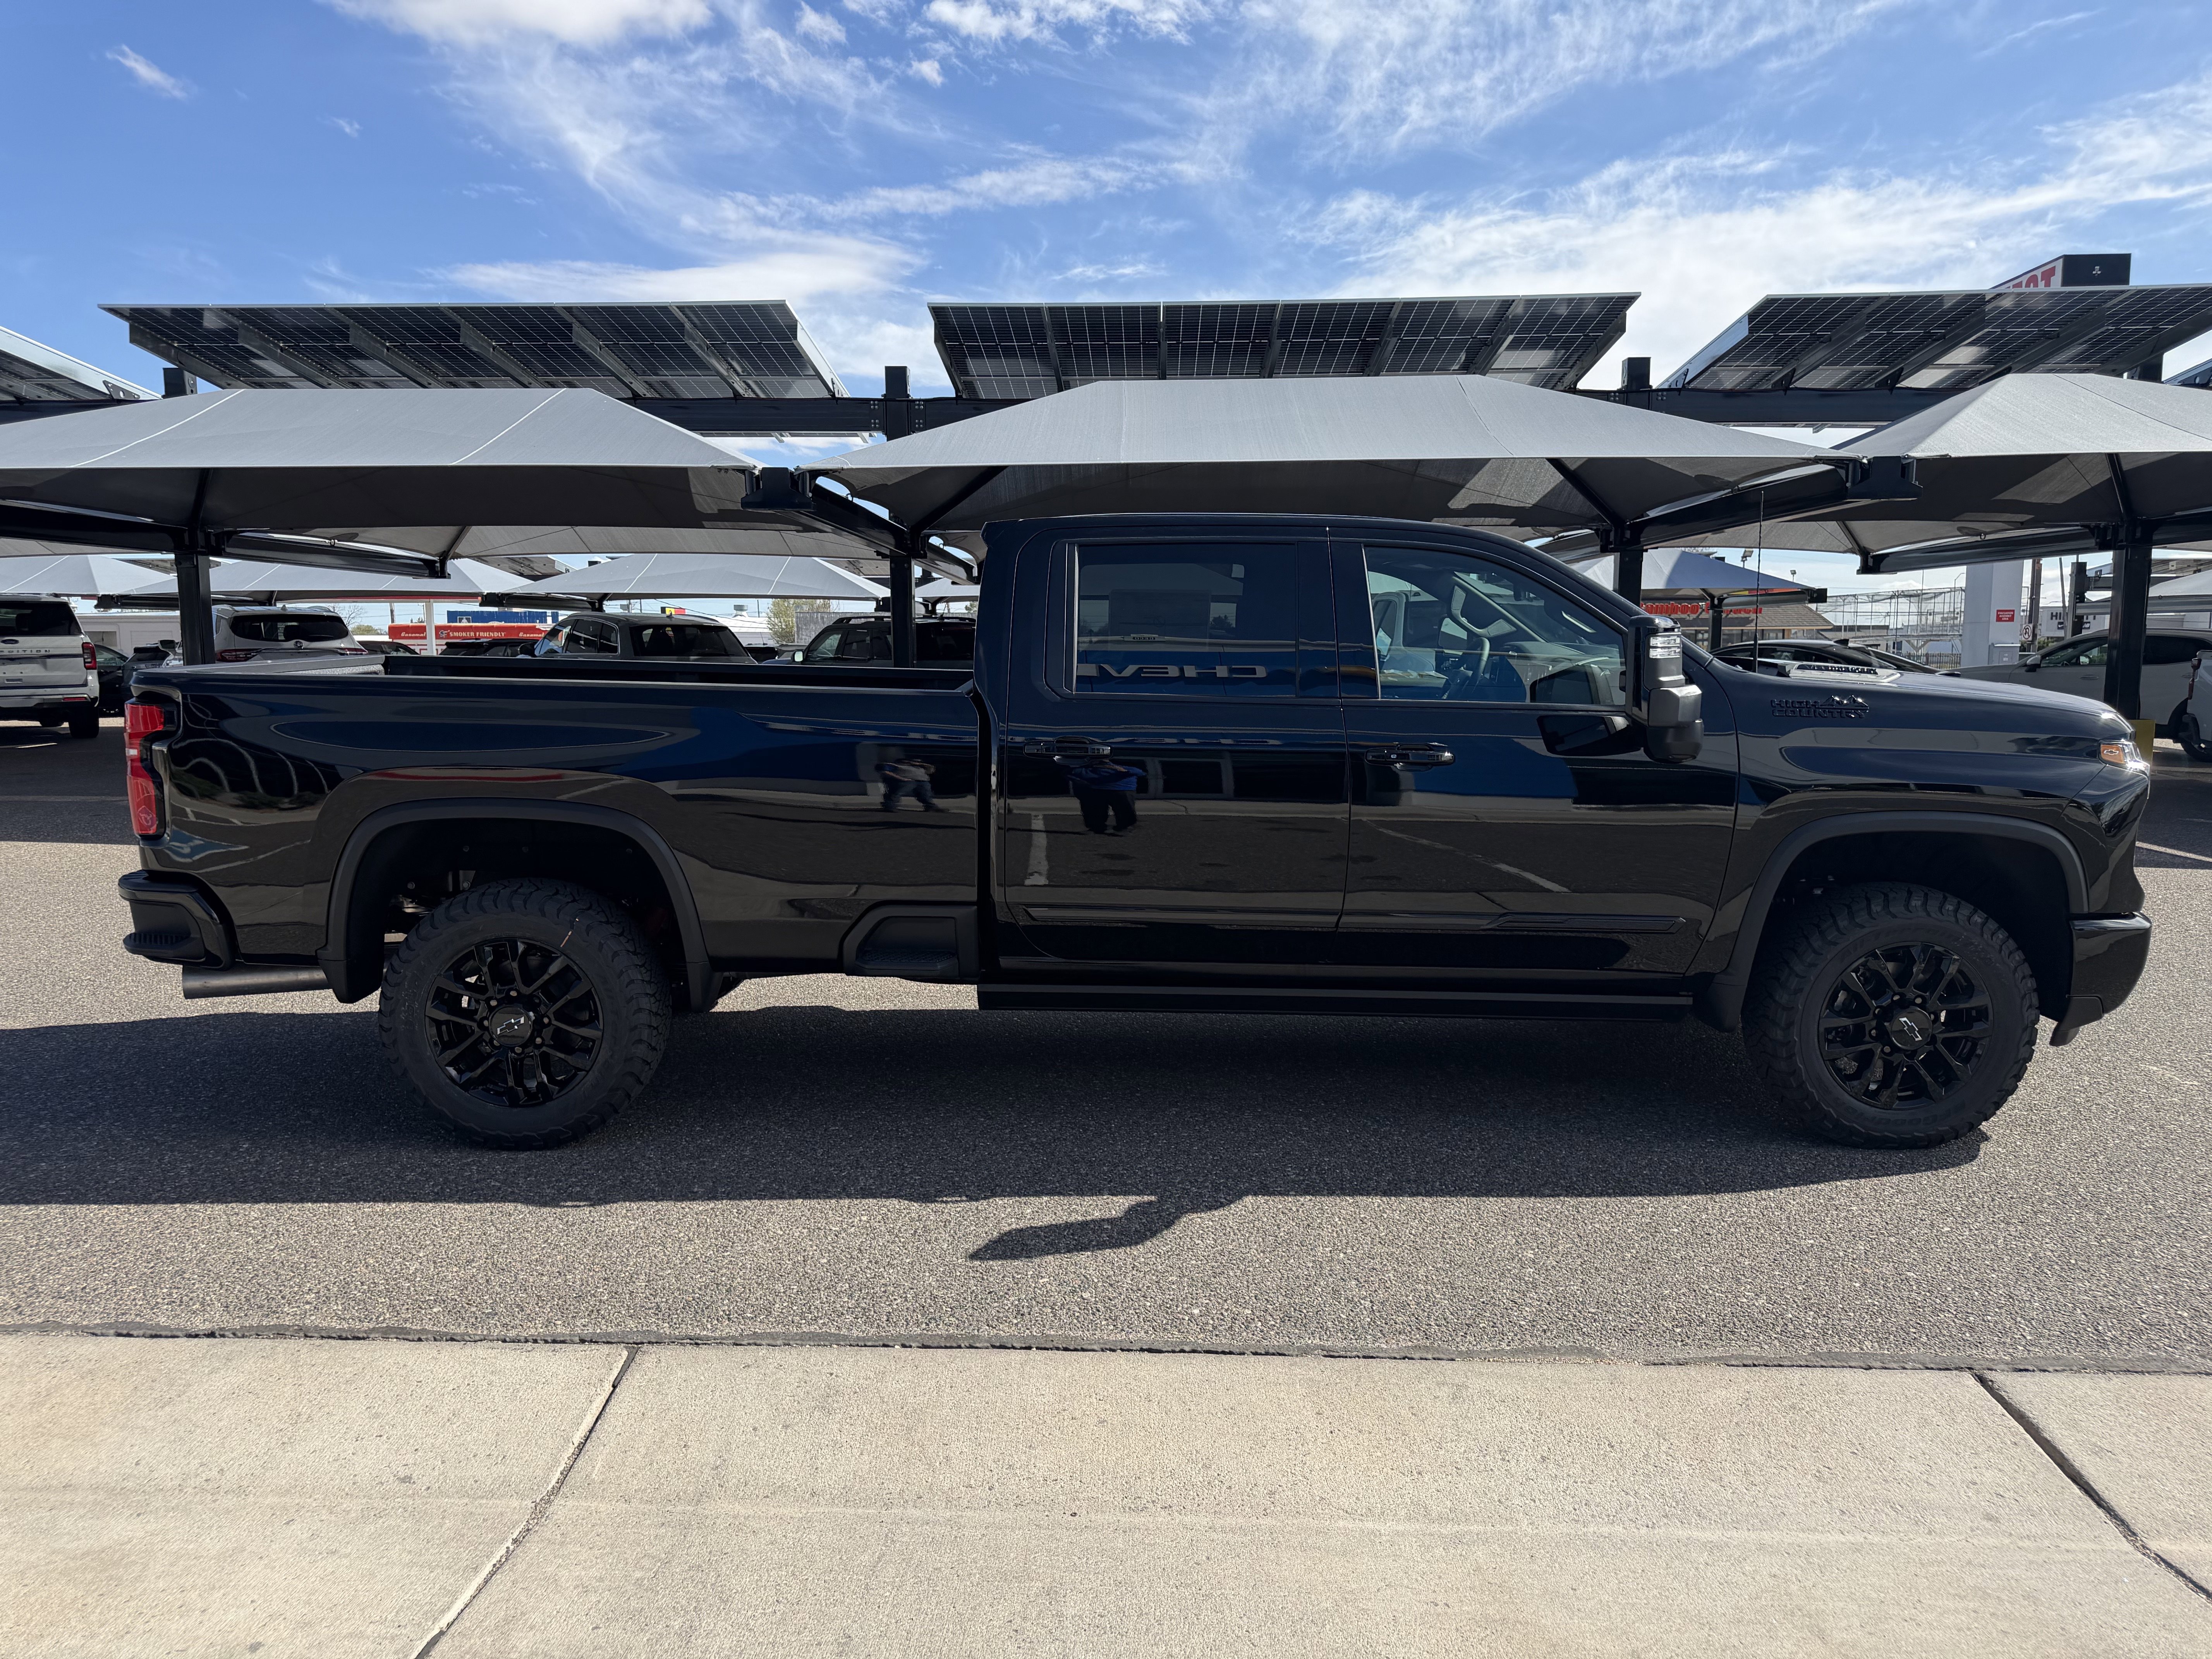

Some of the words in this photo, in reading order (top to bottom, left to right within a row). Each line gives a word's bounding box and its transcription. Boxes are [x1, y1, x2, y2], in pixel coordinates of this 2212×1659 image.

[1640, 601, 1700, 615] amboo
[1771, 699, 1820, 708] HIGH
[1772, 709, 1869, 719] COUNTRY
